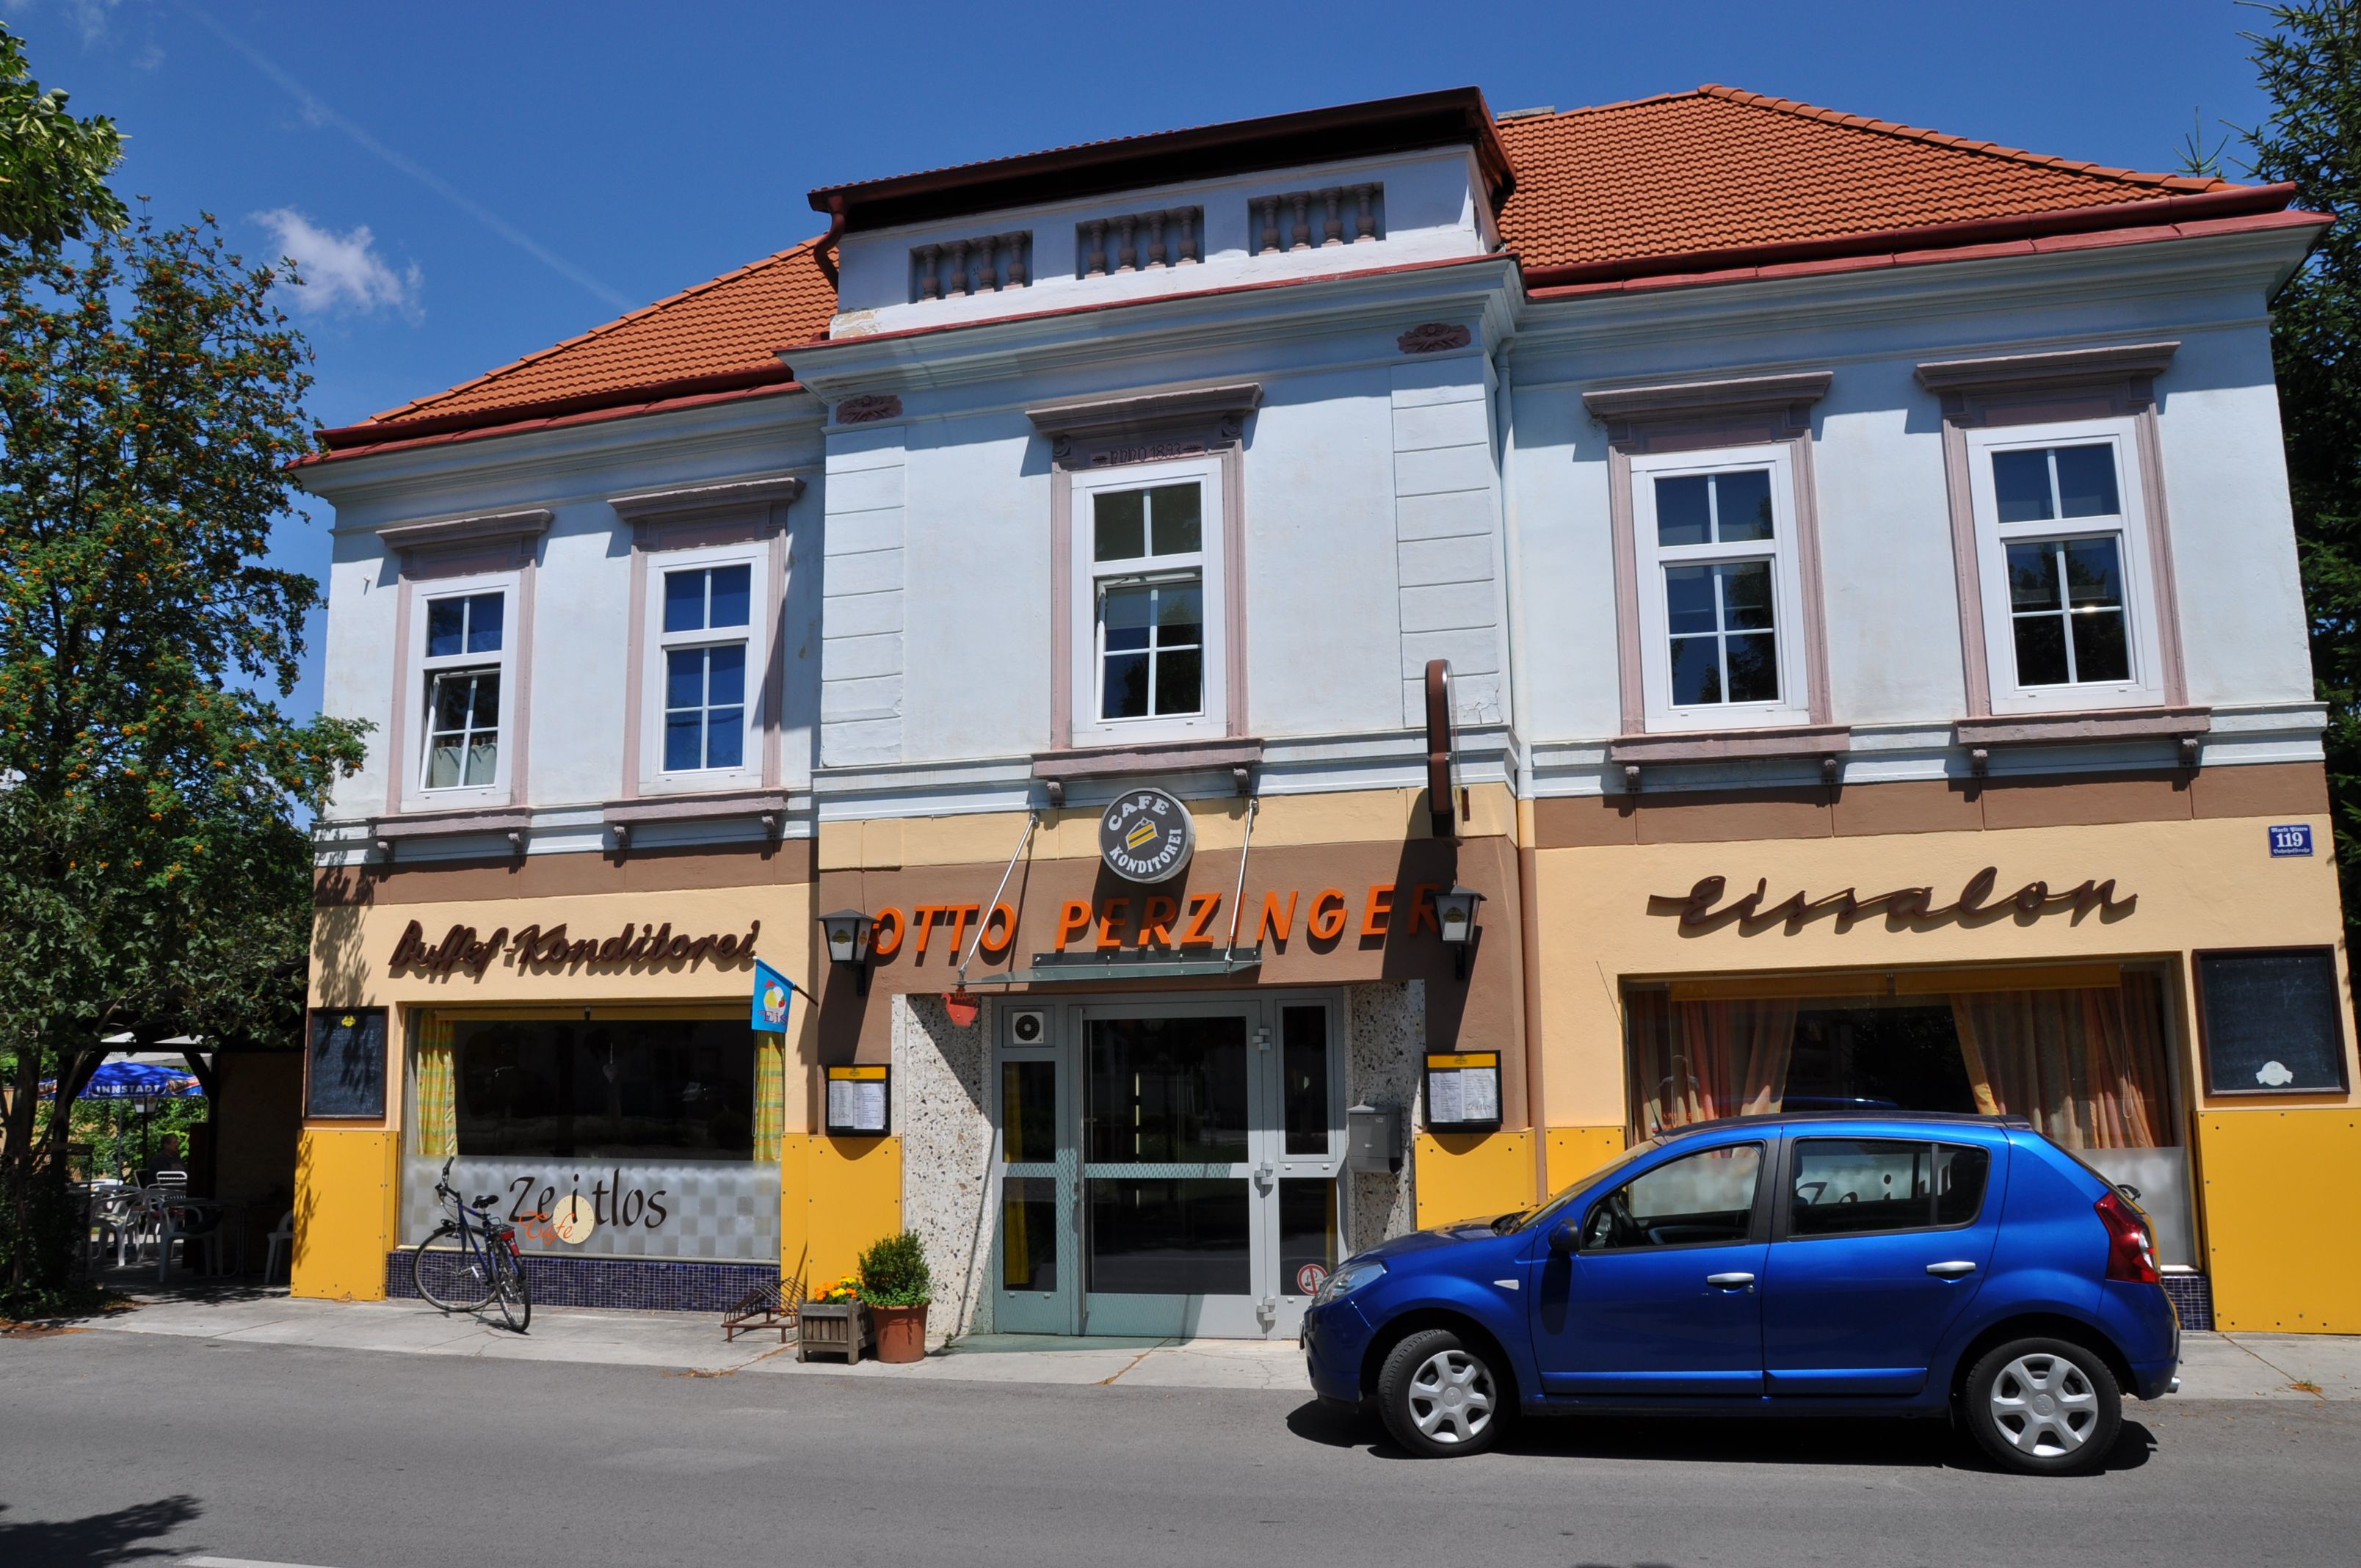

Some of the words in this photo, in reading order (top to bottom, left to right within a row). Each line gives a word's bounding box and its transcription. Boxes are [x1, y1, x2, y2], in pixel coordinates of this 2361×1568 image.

[1150, 443, 1181, 460] 1893
[1108, 795, 1169, 831] CAFE
[1109, 829, 1182, 874] KONDITOREI
[2276, 832, 2304, 848] 119
[1649, 866, 2139, 925] Eissalon
[870, 902, 1016, 955] OTTO
[1055, 883, 1442, 949] PERZINGER
[96, 1084, 160, 1094] INNSTADT
[509, 1168, 667, 1229] Zeitlos
